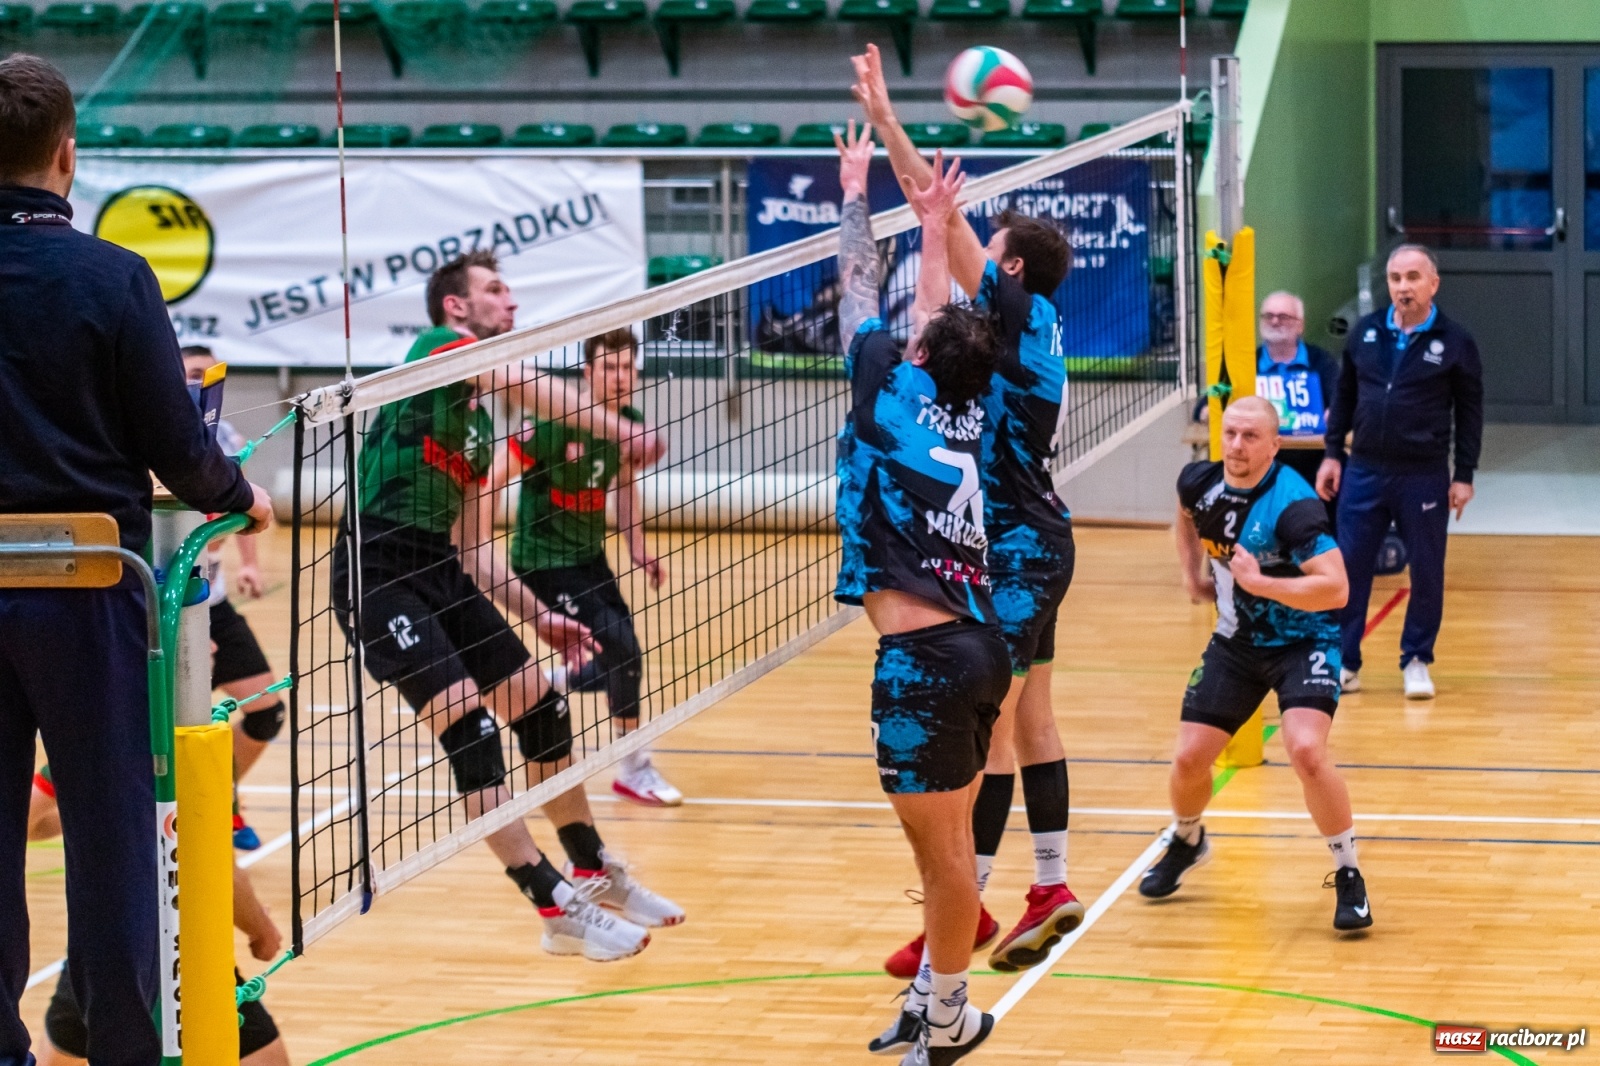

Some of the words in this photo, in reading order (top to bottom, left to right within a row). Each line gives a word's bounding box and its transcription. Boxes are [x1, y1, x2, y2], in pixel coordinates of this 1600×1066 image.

[244, 275, 329, 329] JEST
[338, 262, 375, 298] W
[1286, 380, 1310, 407] 15
[1223, 510, 1237, 539] 2
[388, 615, 420, 650] 12
[1308, 651, 1329, 675] 2
